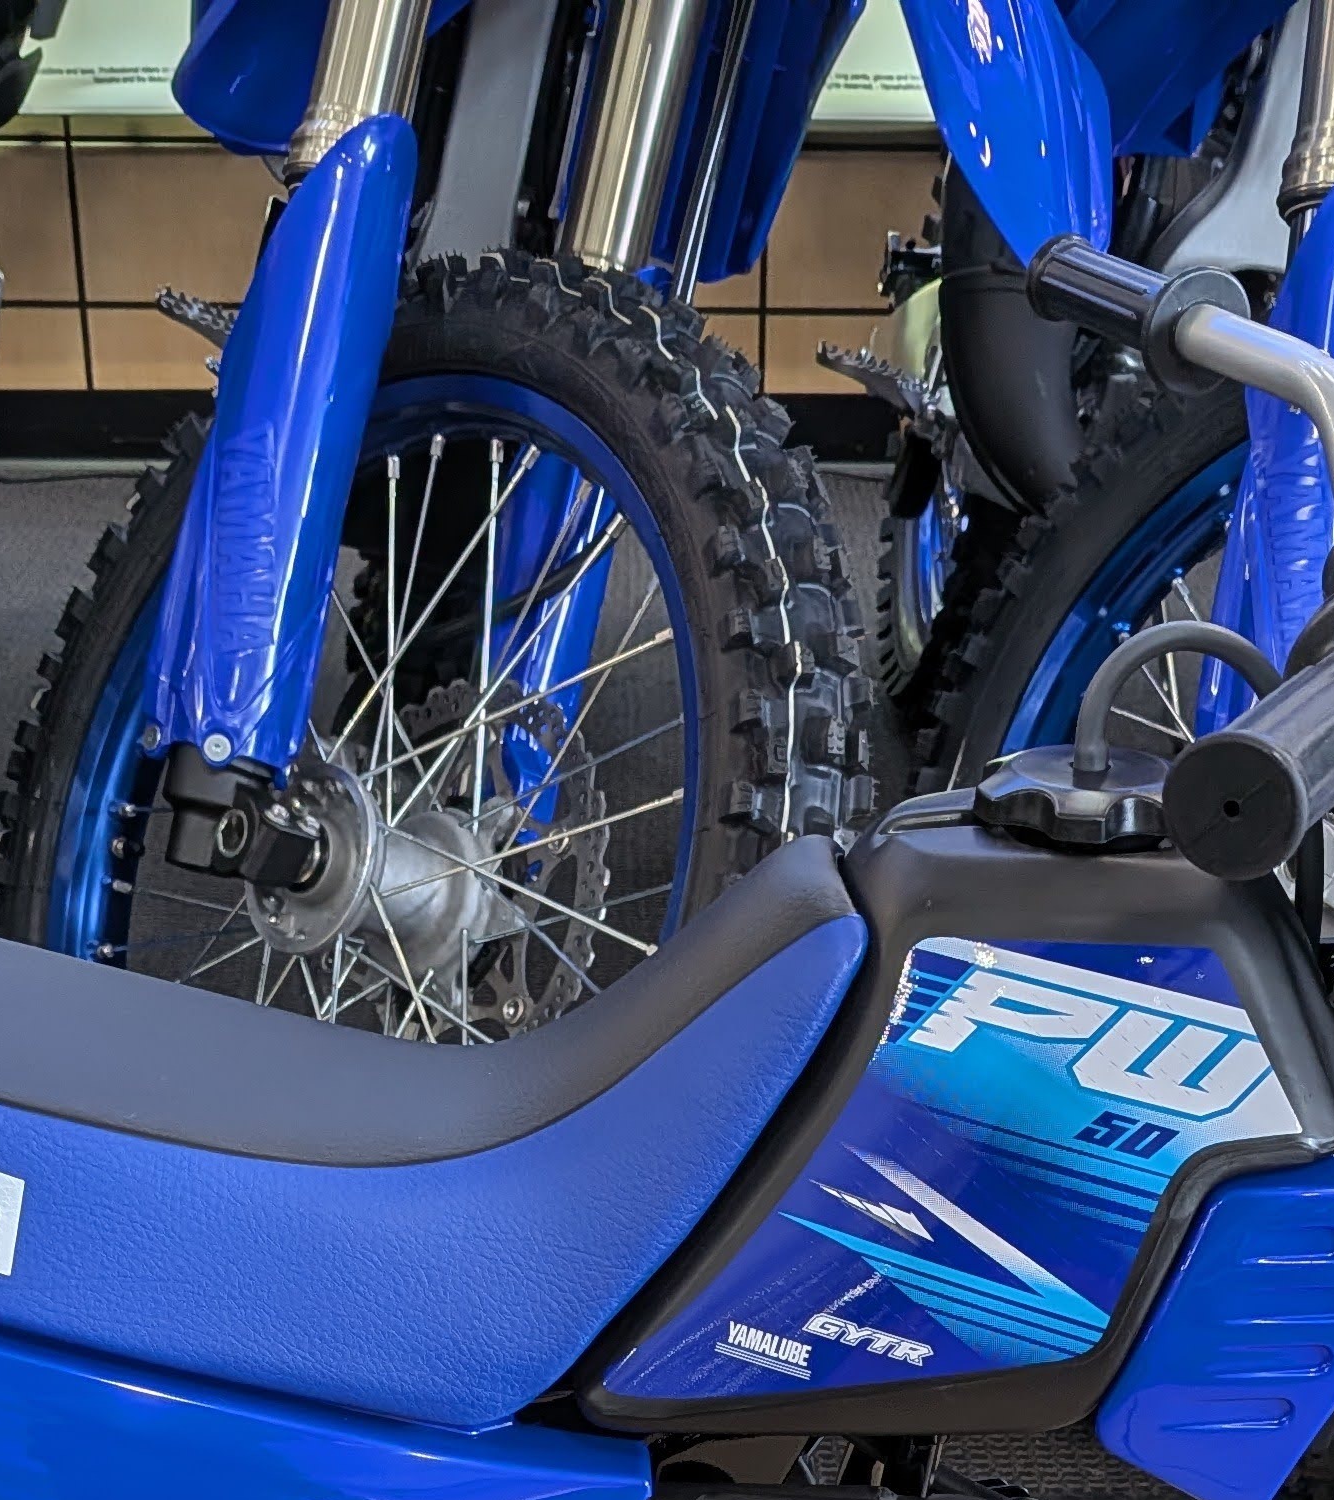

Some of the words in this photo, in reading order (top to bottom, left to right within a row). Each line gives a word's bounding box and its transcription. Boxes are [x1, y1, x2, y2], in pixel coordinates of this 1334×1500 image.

[217, 420, 275, 657] YAMAHA
[1265, 436, 1327, 648] YAMAH
[909, 968, 1271, 1118] PW
[1073, 1110, 1180, 1159] 50
[727, 1321, 812, 1368] YAMALUBE
[802, 1313, 934, 1366] GYTR
